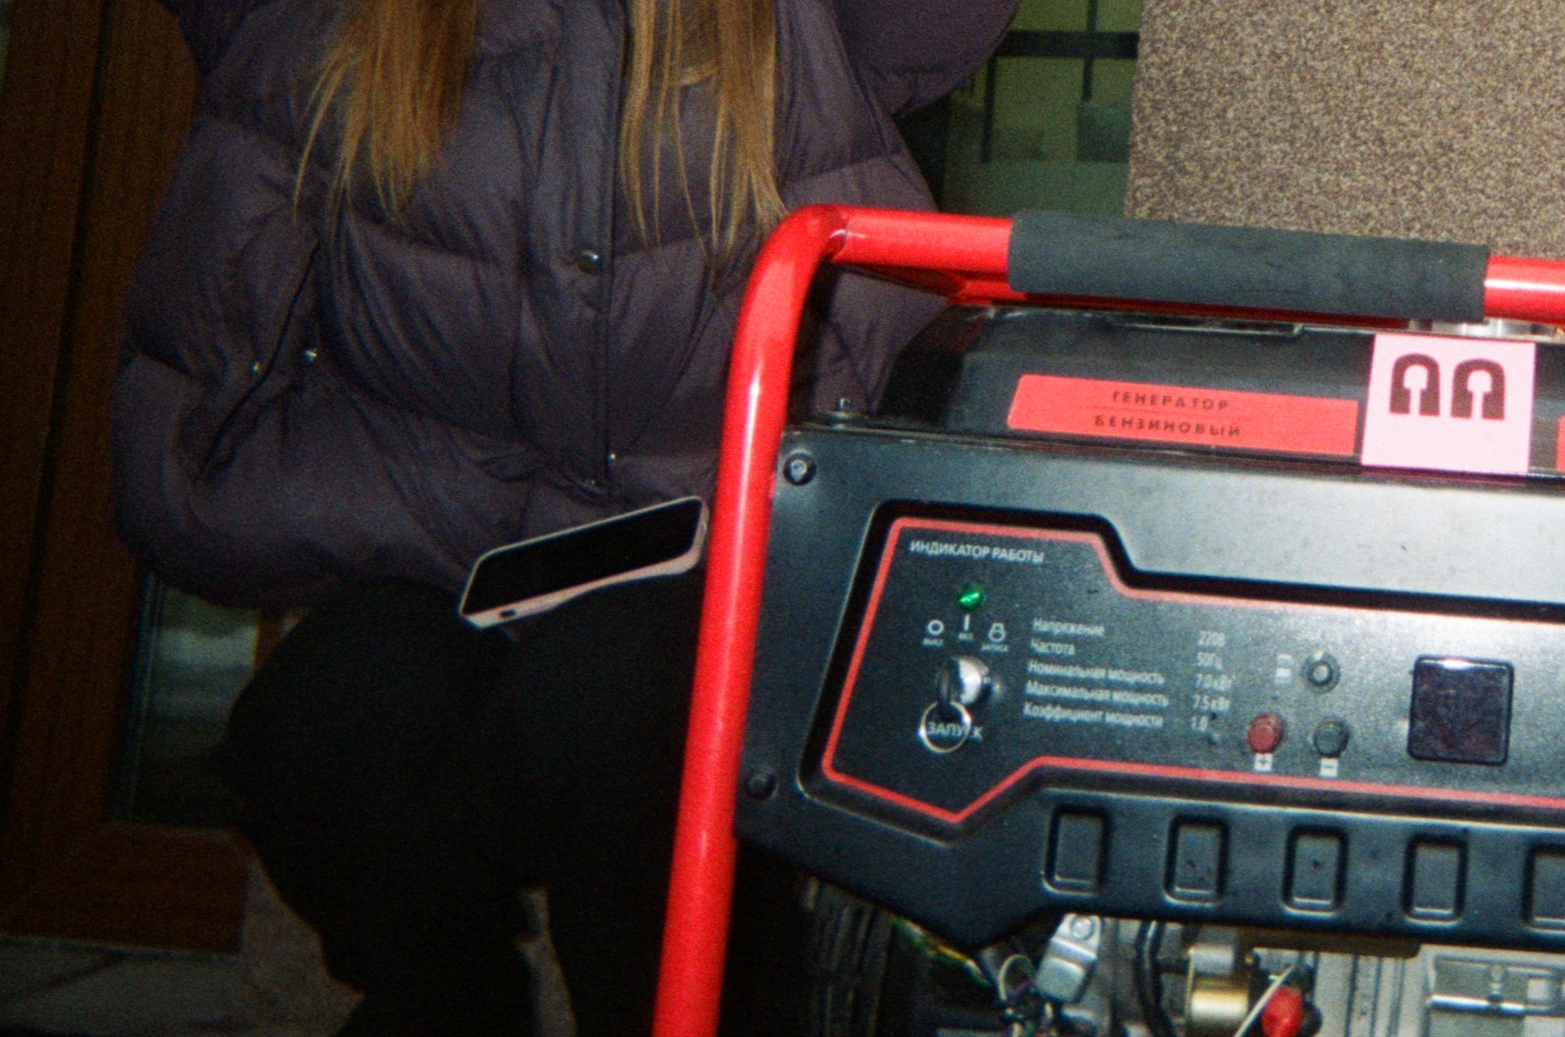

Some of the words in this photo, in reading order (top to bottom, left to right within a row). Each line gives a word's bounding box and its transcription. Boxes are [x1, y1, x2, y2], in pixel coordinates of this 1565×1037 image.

[1111, 389, 1231, 412] ГЕНЕРАТОР
[1093, 413, 1243, 439] БЕНЗИНОВЫЙ
[910, 539, 991, 560] ИНДИКАТОР
[992, 546, 1046, 564] РАБОТЫ
